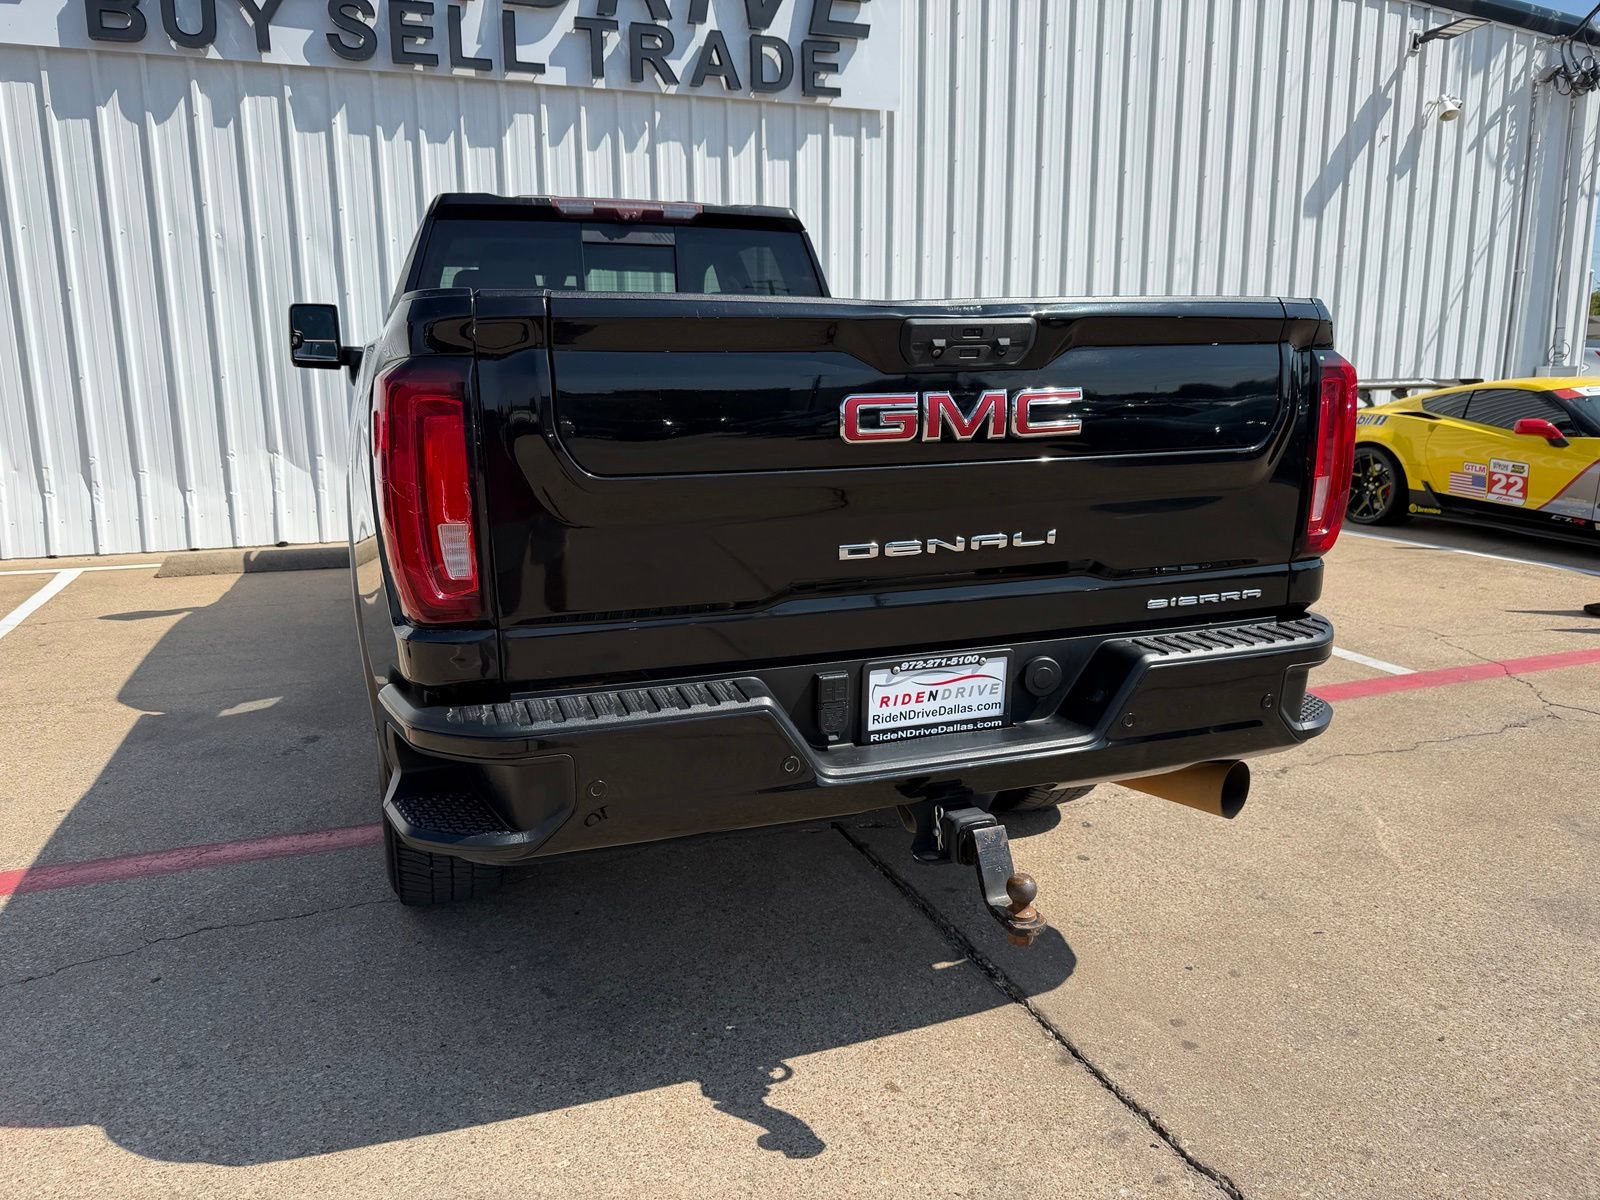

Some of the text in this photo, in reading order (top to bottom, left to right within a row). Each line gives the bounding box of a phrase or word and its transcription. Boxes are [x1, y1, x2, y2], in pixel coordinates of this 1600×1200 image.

[85, 0, 284, 53] BUY
[325, 0, 546, 74] SELL
[574, 16, 842, 98] TRADE
[839, 386, 1083, 445] GMC
[1356, 413, 1376, 425] bil
[1464, 463, 1486, 473] GTLM
[1491, 473, 1524, 498] 22
[838, 528, 1057, 561] DENALI
[1147, 588, 1263, 610] SIERRA
[900, 654, 979, 671] 972-271-5100
[872, 701, 1001, 726] RideNDriveDallas.com
[870, 719, 1002, 742] RideNDriveDallas.com
